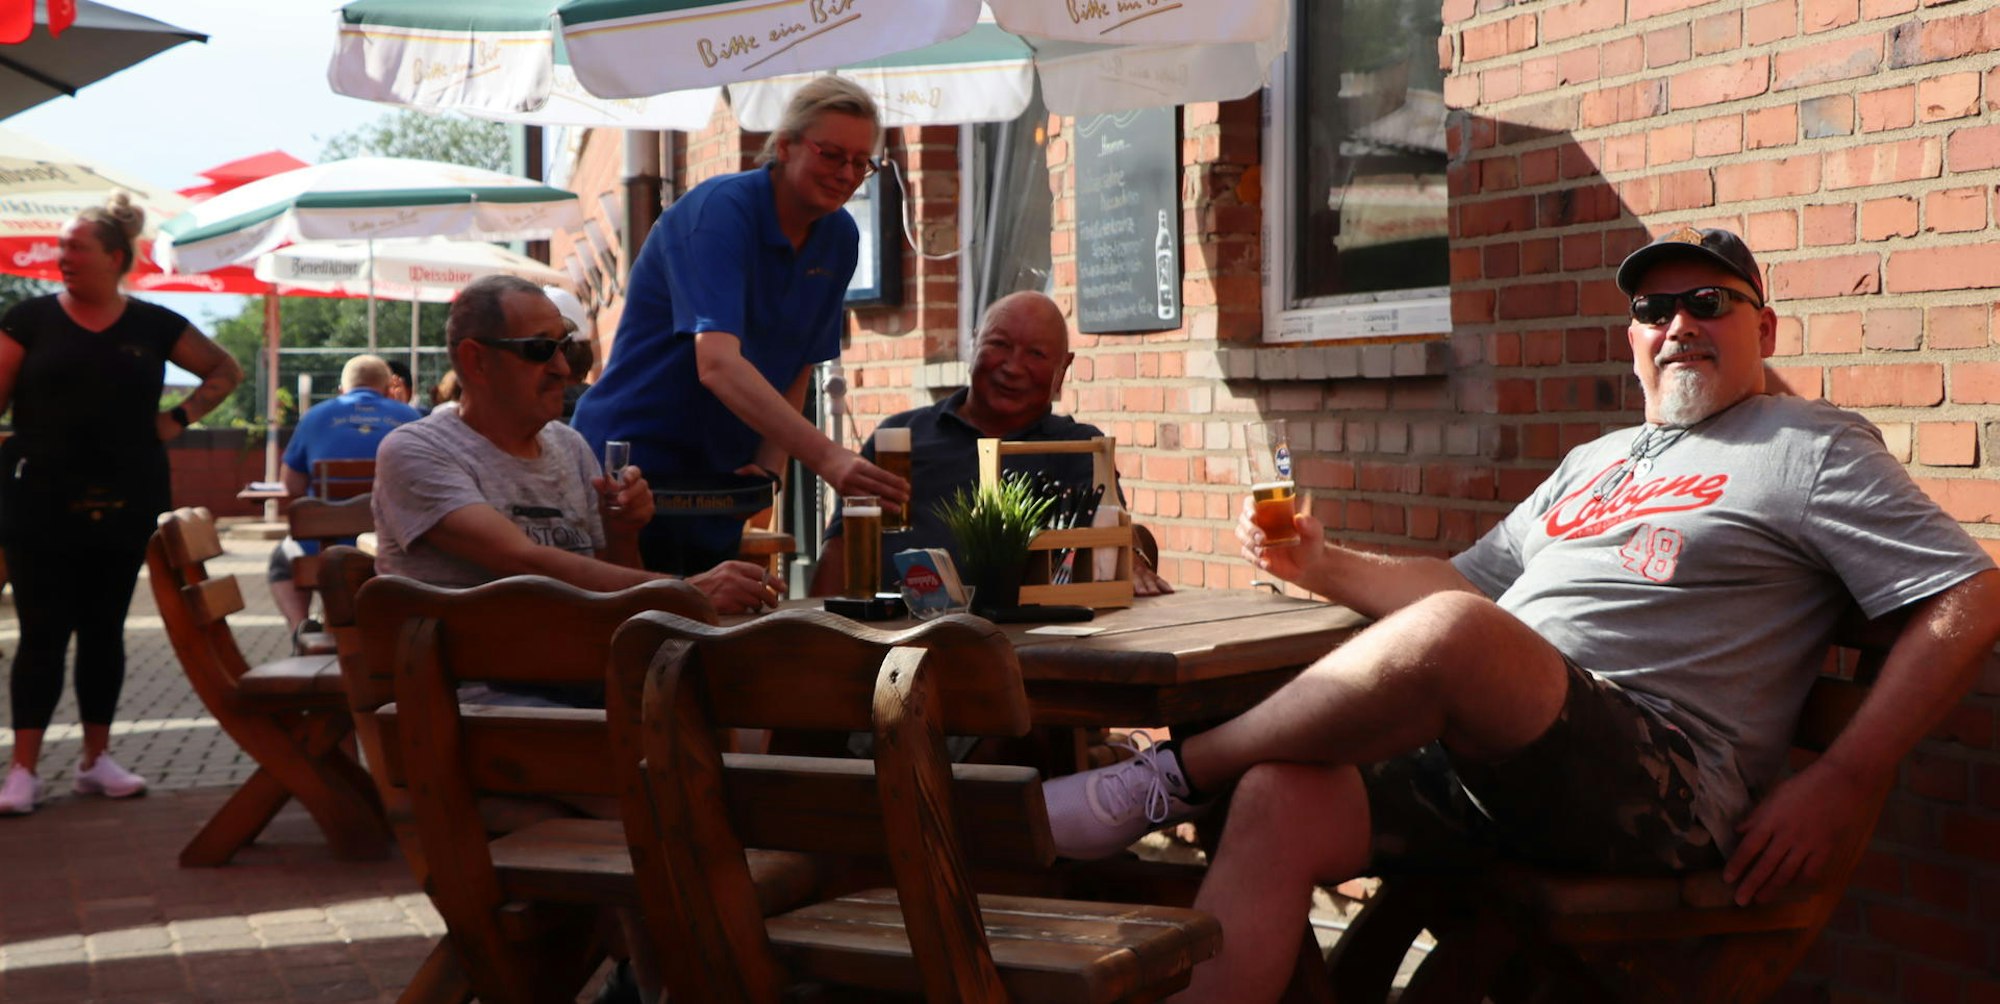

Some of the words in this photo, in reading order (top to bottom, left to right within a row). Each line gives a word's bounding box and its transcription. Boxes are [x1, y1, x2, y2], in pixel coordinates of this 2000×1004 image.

[696, 35, 760, 69] Bitte
[768, 22, 806, 42] ein
[408, 265, 473, 283] Weissbier
[1619, 522, 1684, 583] 48
